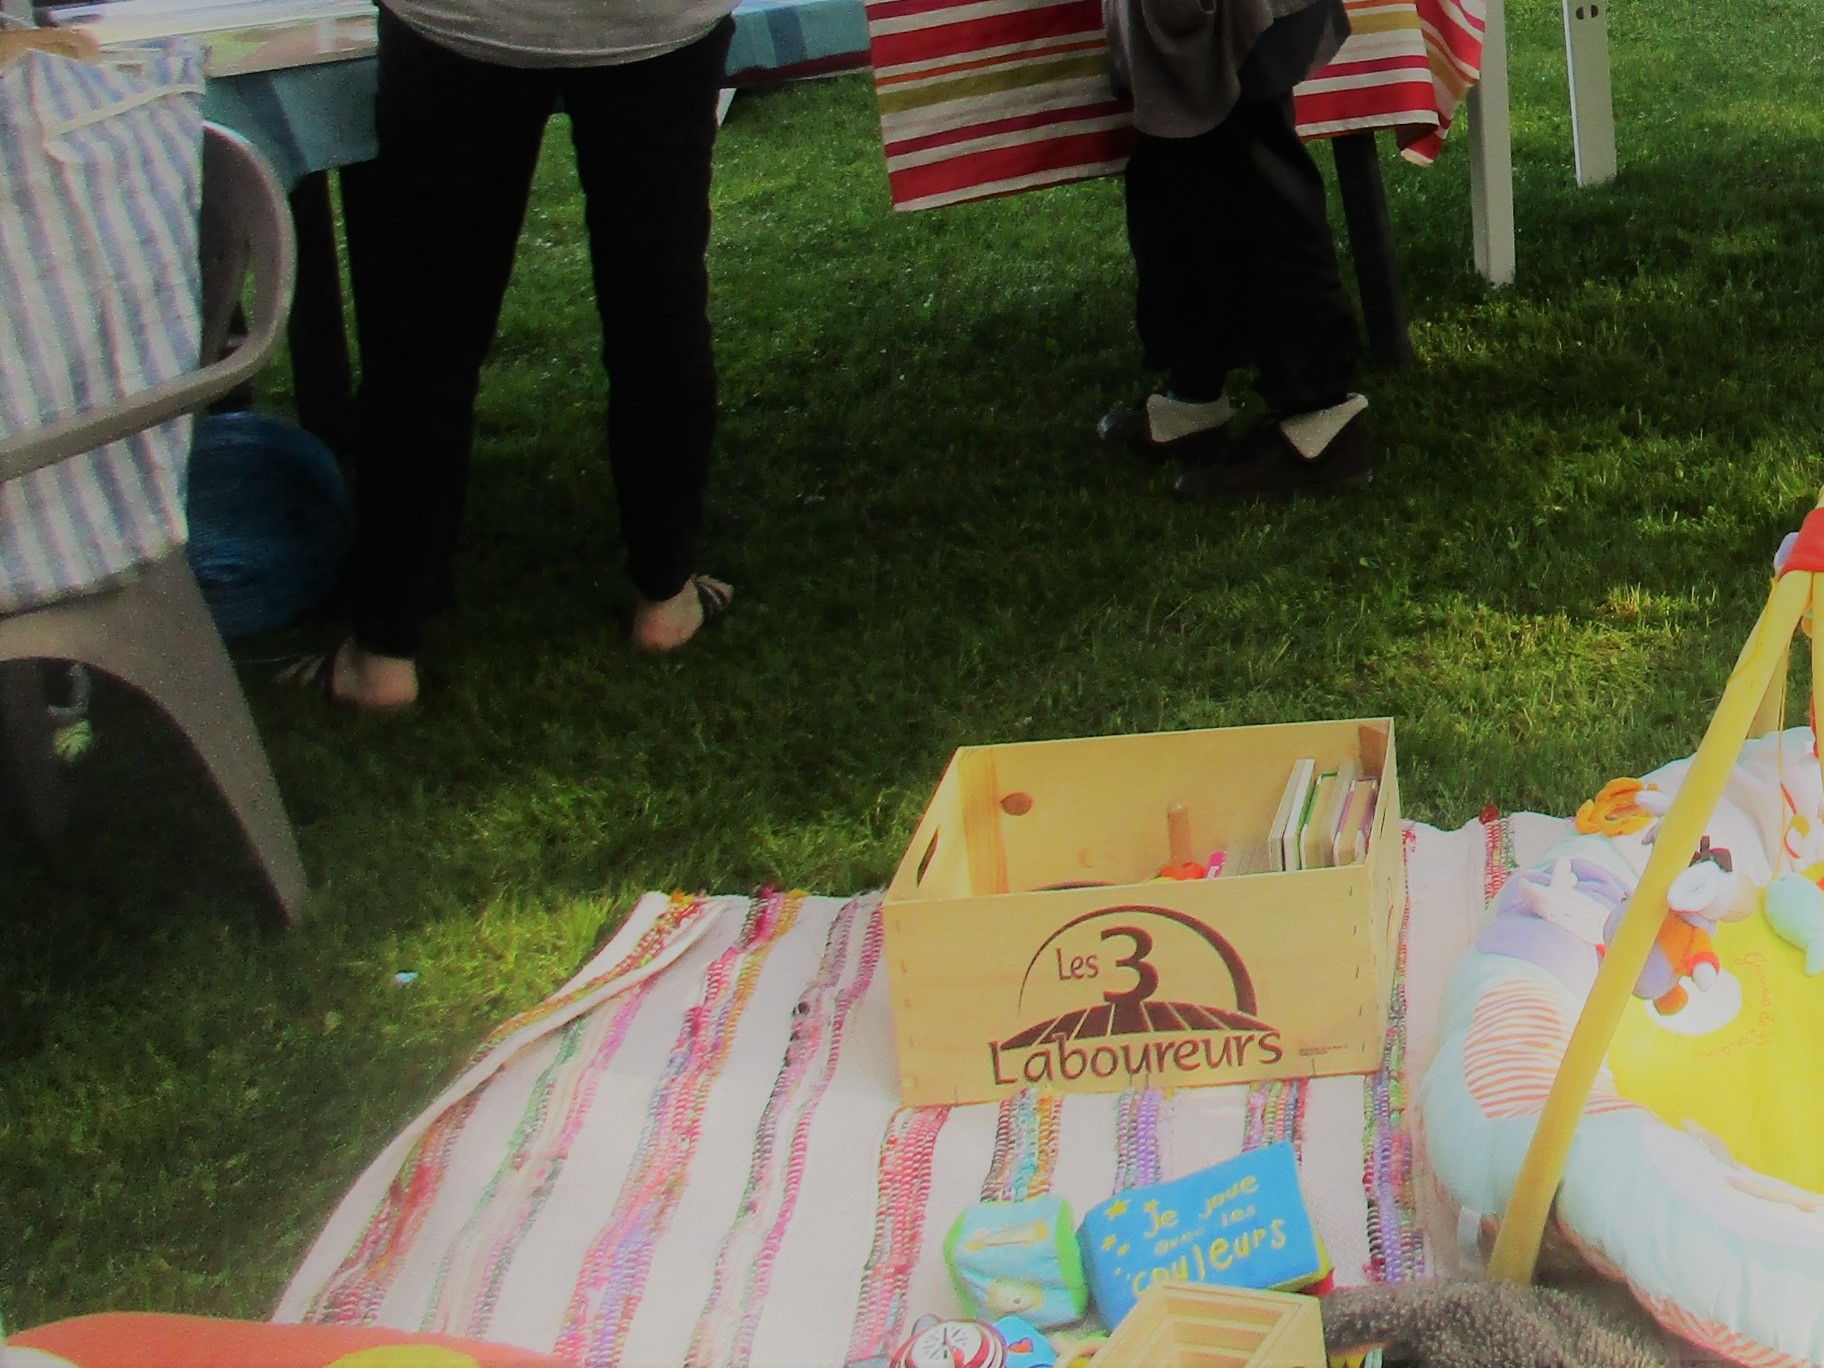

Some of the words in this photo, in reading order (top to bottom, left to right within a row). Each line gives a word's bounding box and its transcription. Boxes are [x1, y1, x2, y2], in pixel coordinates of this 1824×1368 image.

[1056, 947, 1099, 981] Les
[1100, 925, 1159, 1004] 3
[988, 1029, 1284, 1086] Laboureurs
[1132, 1217, 1286, 1297] couleurs
